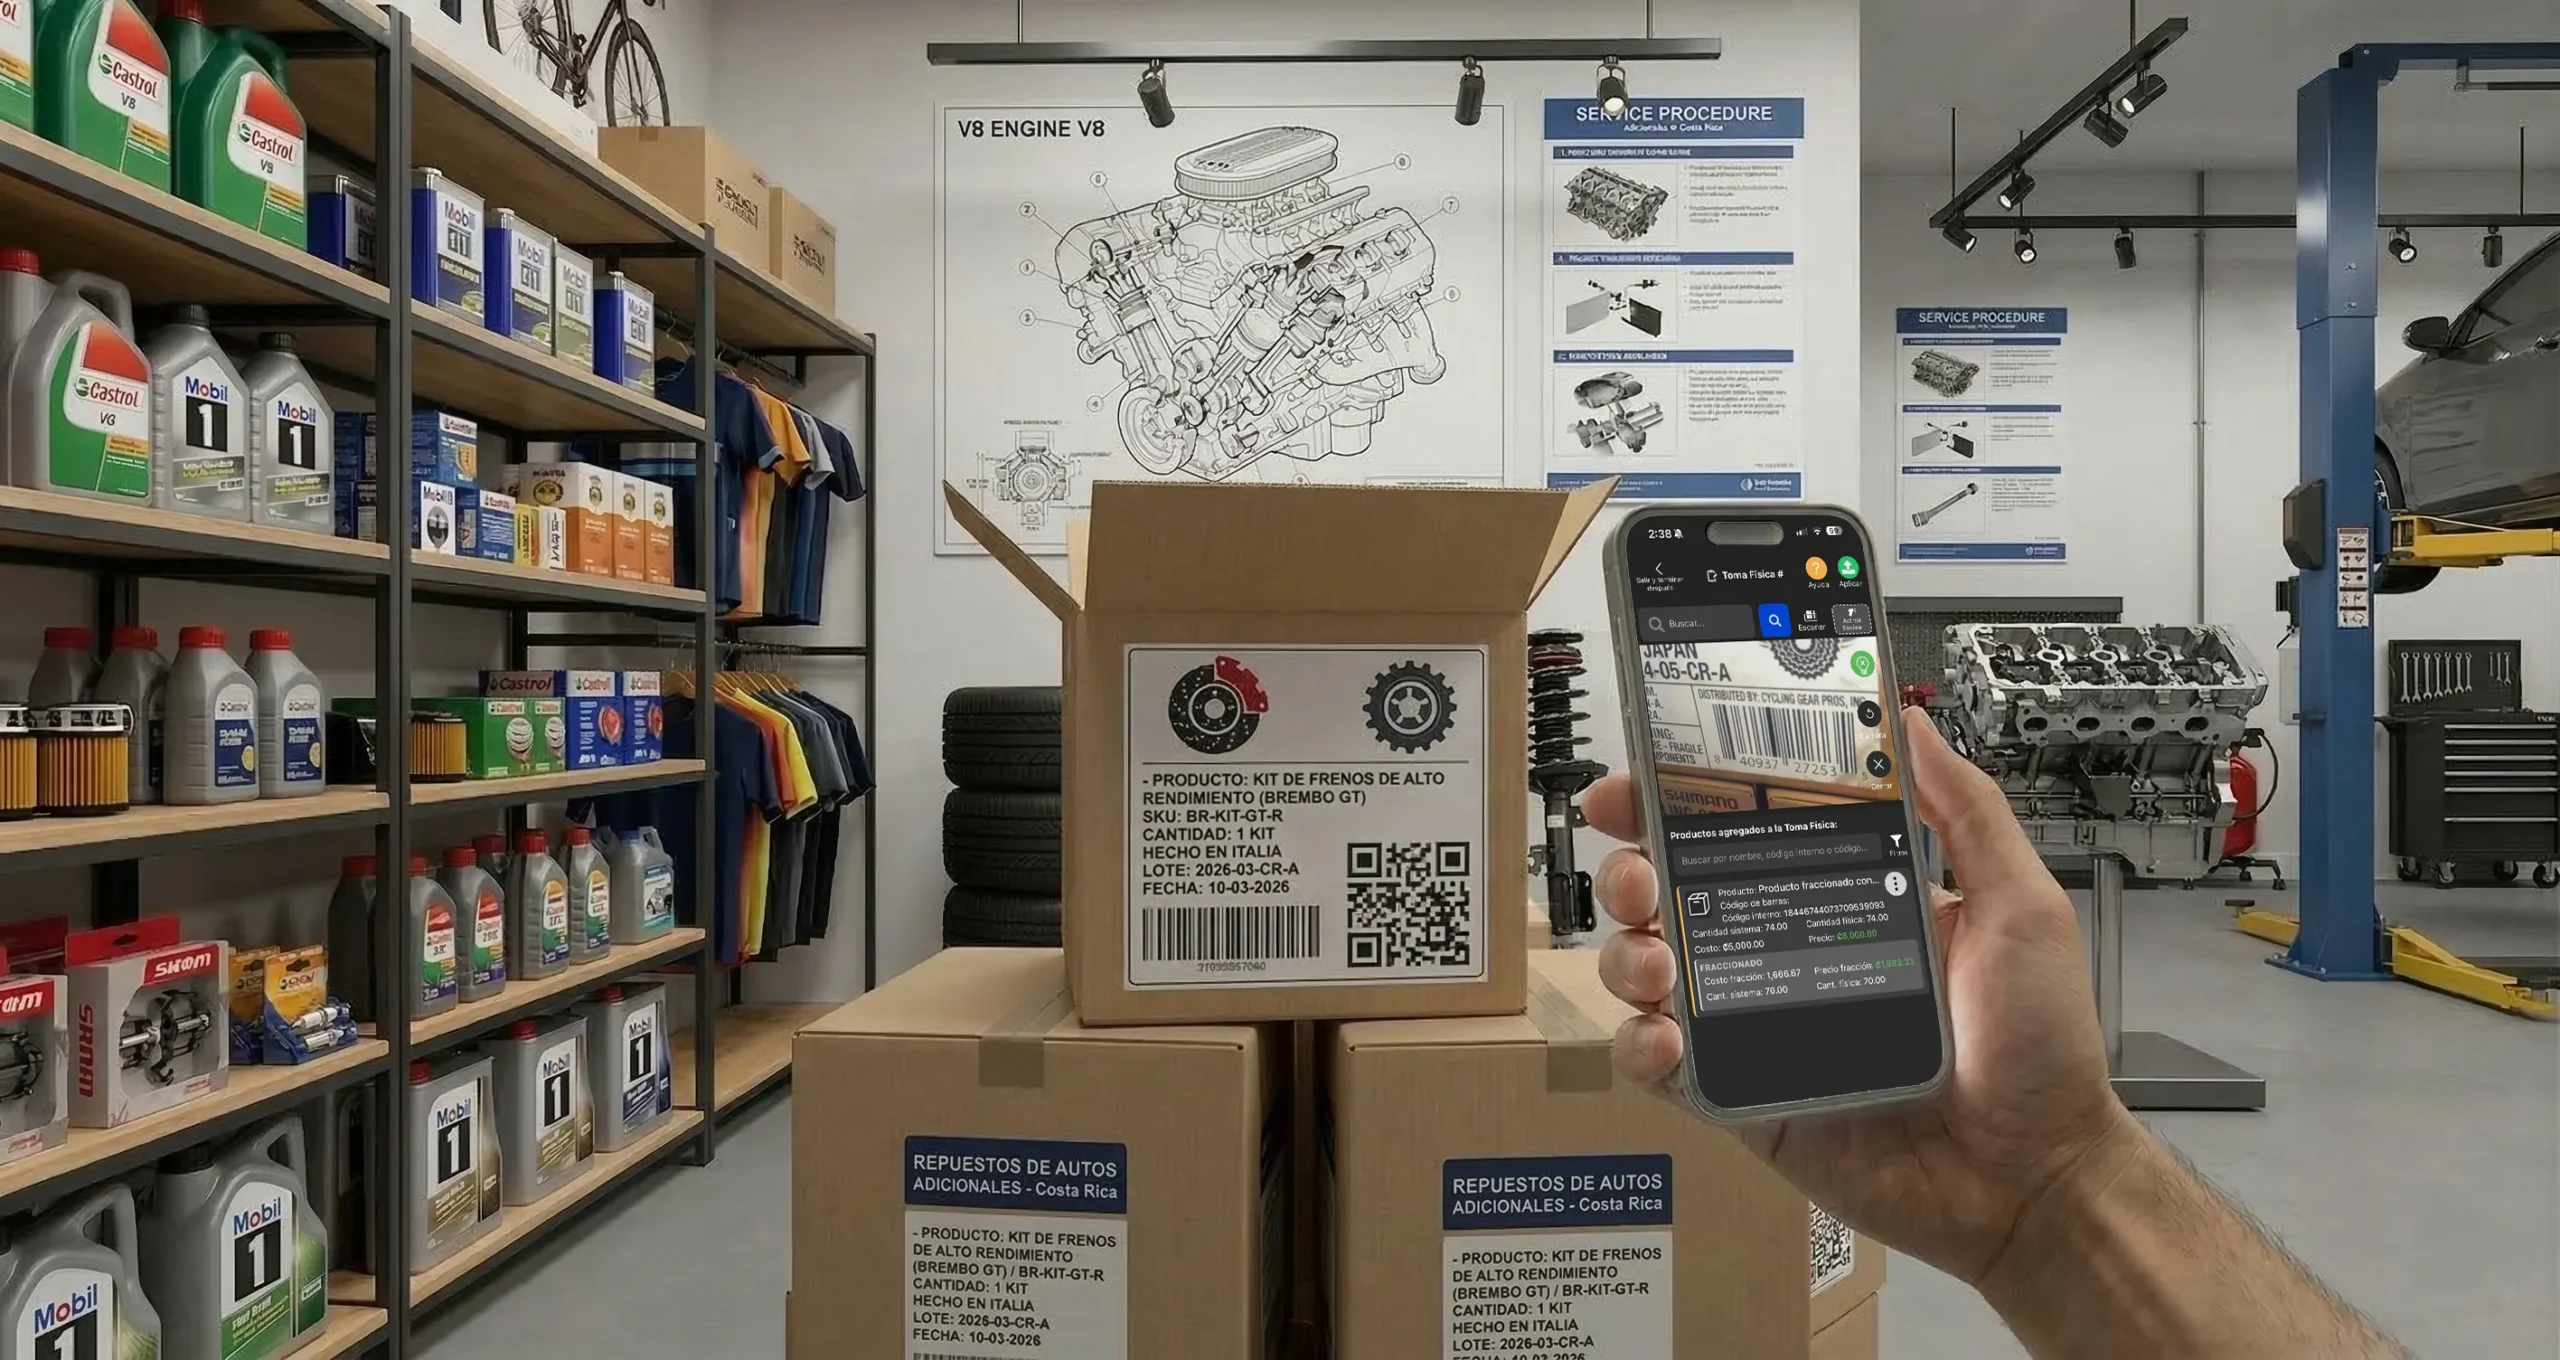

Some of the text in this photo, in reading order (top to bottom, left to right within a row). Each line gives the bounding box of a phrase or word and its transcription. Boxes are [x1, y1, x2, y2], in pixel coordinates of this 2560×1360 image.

[113, 61, 157, 98] Castrol
[1576, 106, 1772, 121] SERICE PROCEDURE
[958, 120, 1105, 137] V8 ENGINE V8
[251, 130, 293, 161] Castrol
[1919, 312, 2045, 323] SERVICE PROCEDURE
[90, 383, 138, 408] Castrol
[185, 376, 228, 402] Mobil
[278, 401, 316, 423] Mobil
[198, 403, 213, 447] 1
[289, 426, 302, 465] 1
[1649, 530, 1672, 539] 2:38
[1722, 570, 1775, 580] Toma Física
[1669, 620, 1704, 628] Buscar...
[1643, 643, 1698, 659] JAPAN
[500, 677, 551, 690] Castrol
[1698, 689, 1848, 708] DISTRIBUTED BY: CYCLING GEAR PROS,
[1669, 742, 1703, 754] FRAGILE
[1740, 757, 1868, 781] 40937 27253 5
[1153, 772, 1445, 786] PRODUCTO: KIT DE FRENOS DE ALTO
[1143, 791, 1366, 807] RENDIMIENTO (BREMBO GT)
[1664, 789, 1738, 809] SHIMANO
[1143, 810, 1283, 823] SKU: BR-KIT-GT-R
[1143, 827, 1275, 841] CANTIDAD: 1 KIT
[1670, 829, 1716, 840] Productos
[1719, 825, 1765, 838] agregados
[1784, 823, 1808, 832] Toma
[1810, 821, 1838, 830] Física:
[1143, 845, 1282, 859] HECHO EN ITALIA
[1682, 855, 1711, 865] Buscar
[1713, 855, 1727, 864] por
[1729, 852, 1764, 863] nombre,
[1766, 849, 1793, 860] código
[1795, 848, 1824, 857] interno
[1143, 863, 1299, 877] LOTE: 2026-03-CR-A
[1143, 881, 1289, 895] FECHA: 10-03-2026
[1718, 877, 1880, 897] Producto: Producto fraccionado con...
[1720, 897, 1789, 911] Código de barras:
[1722, 913, 1750, 924] Código
[1806, 913, 1889, 928] Cantidad 74.00
[1692, 923, 1788, 939] Cantidad sistema: 74.00
[1809, 934, 1835, 944] Precio:
[1695, 943, 1721, 954] Costo:
[1700, 959, 1763, 972] FRACCIONADO
[1814, 965, 1838, 975] Precio
[1705, 976, 1728, 986] Costo
[1767, 969, 1800, 980] 1,666.67
[1817, 976, 1886, 991] Cant. 70.00
[1707, 991, 1728, 1001] Cant.
[1765, 986, 1788, 995] 70.00
[637, 1038, 644, 1075] 1
[543, 1053, 570, 1078] Mobil
[552, 1076, 562, 1120] 1
[437, 1099, 471, 1128] Mobil
[447, 1125, 460, 1174] 1
[913, 1155, 1117, 1177] REPUESTOS DE AUTOS
[913, 1177, 1117, 1199] ADICIONALES Costa Rica
[1453, 1174, 1662, 1194] REPUESTOS DE AUTOS
[1453, 1197, 1662, 1214] ADICIONALES Costa Rica
[233, 1197, 281, 1236] Mobil
[922, 1227, 1116, 1247] PRODUCTO: KIT DE FRENOS
[248, 1233, 265, 1287] 1
[913, 1244, 1073, 1262] DE ALTO RENDIMIENTO
[1462, 1248, 1662, 1264] PRODUCTO: KIT DE FRENOS
[913, 1261, 1104, 1282] (BREMBO GT) BR-KIT-GT-R
[1453, 1266, 1618, 1282] DE ALTO RENDIMIENTO
[913, 1278, 1028, 1294] CANTIDAD: KIT
[1453, 1283, 1649, 1301] (BREMBO GT) BR-KIT-GT-R
[35, 1284, 97, 1334] Mobil
[913, 1295, 1035, 1311] HECHO EN ITALIA
[1453, 1302, 1572, 1317] CANTIDAD: KIT
[913, 1312, 954, 1325] LOTE:
[1453, 1319, 1579, 1334] HECHO EN ITALIA
[913, 1329, 1041, 1346] FECHA: 10-03-2026
[1453, 1336, 1594, 1351] LOTE: 2026-03-CR-A
